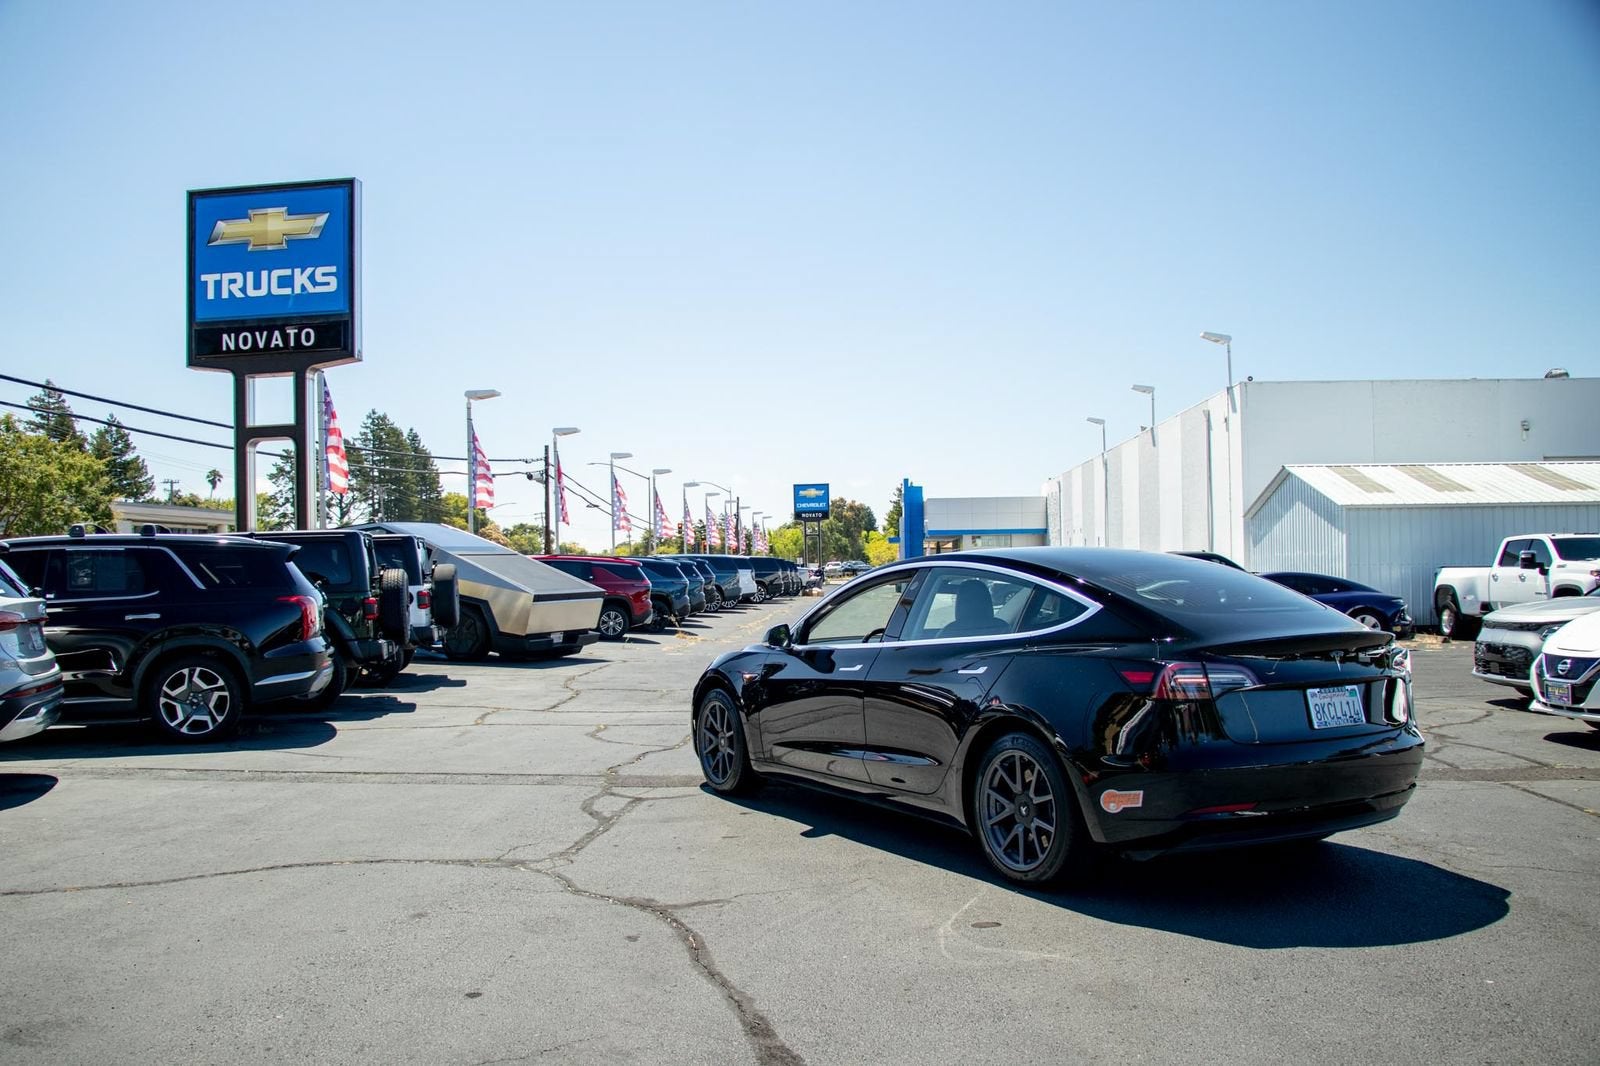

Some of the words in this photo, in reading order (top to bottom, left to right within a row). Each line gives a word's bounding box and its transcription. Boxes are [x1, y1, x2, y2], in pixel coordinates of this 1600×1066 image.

[200, 266, 337, 300] TRUCKS
[222, 328, 315, 351] NOVATO
[1314, 700, 1360, 721] 8KCL414
